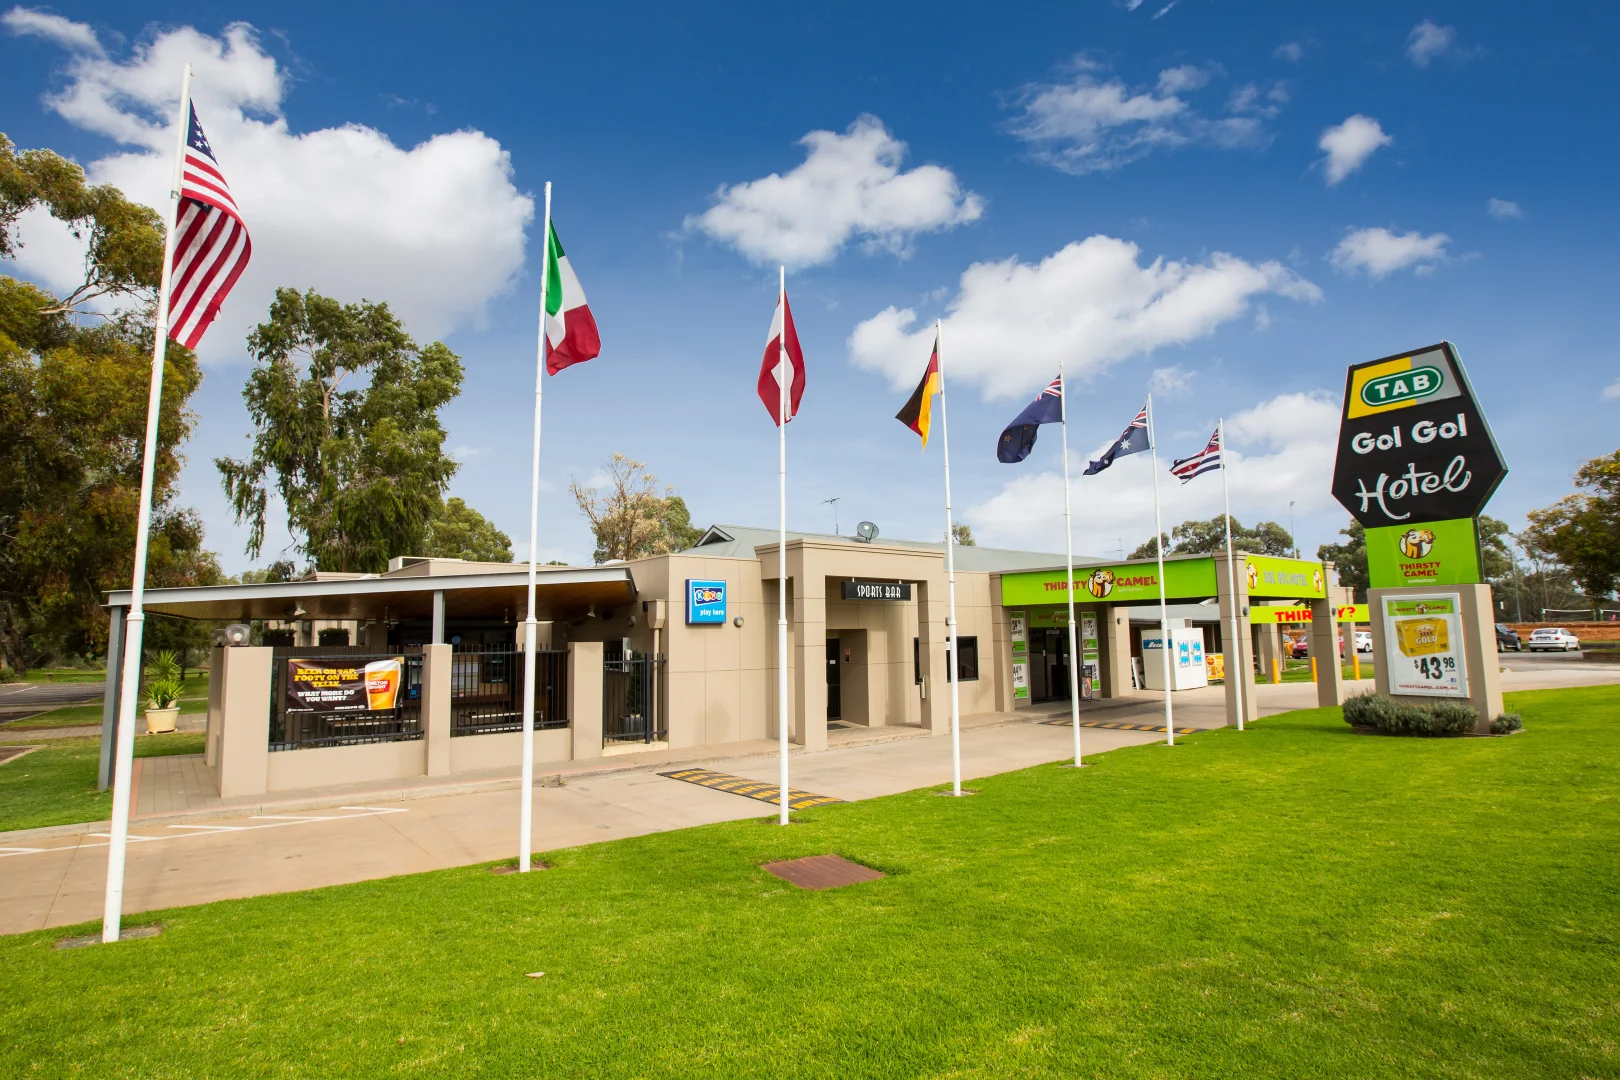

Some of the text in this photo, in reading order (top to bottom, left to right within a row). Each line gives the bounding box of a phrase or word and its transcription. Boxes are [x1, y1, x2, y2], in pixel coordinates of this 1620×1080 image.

[1374, 374, 1431, 399] TAB
[1351, 412, 1468, 455] Gol Gol
[1354, 455, 1472, 520] Hotel
[1399, 561, 1441, 571] THIRSTY
[1263, 571, 1308, 587] GOL GOL HOTEL
[1404, 569, 1438, 577] CAMEL
[1116, 576, 1158, 587] CAMEL
[695, 590, 722, 601] KENO
[857, 585, 901, 598] SPORTS BAR
[1415, 635, 1438, 645] GOLD
